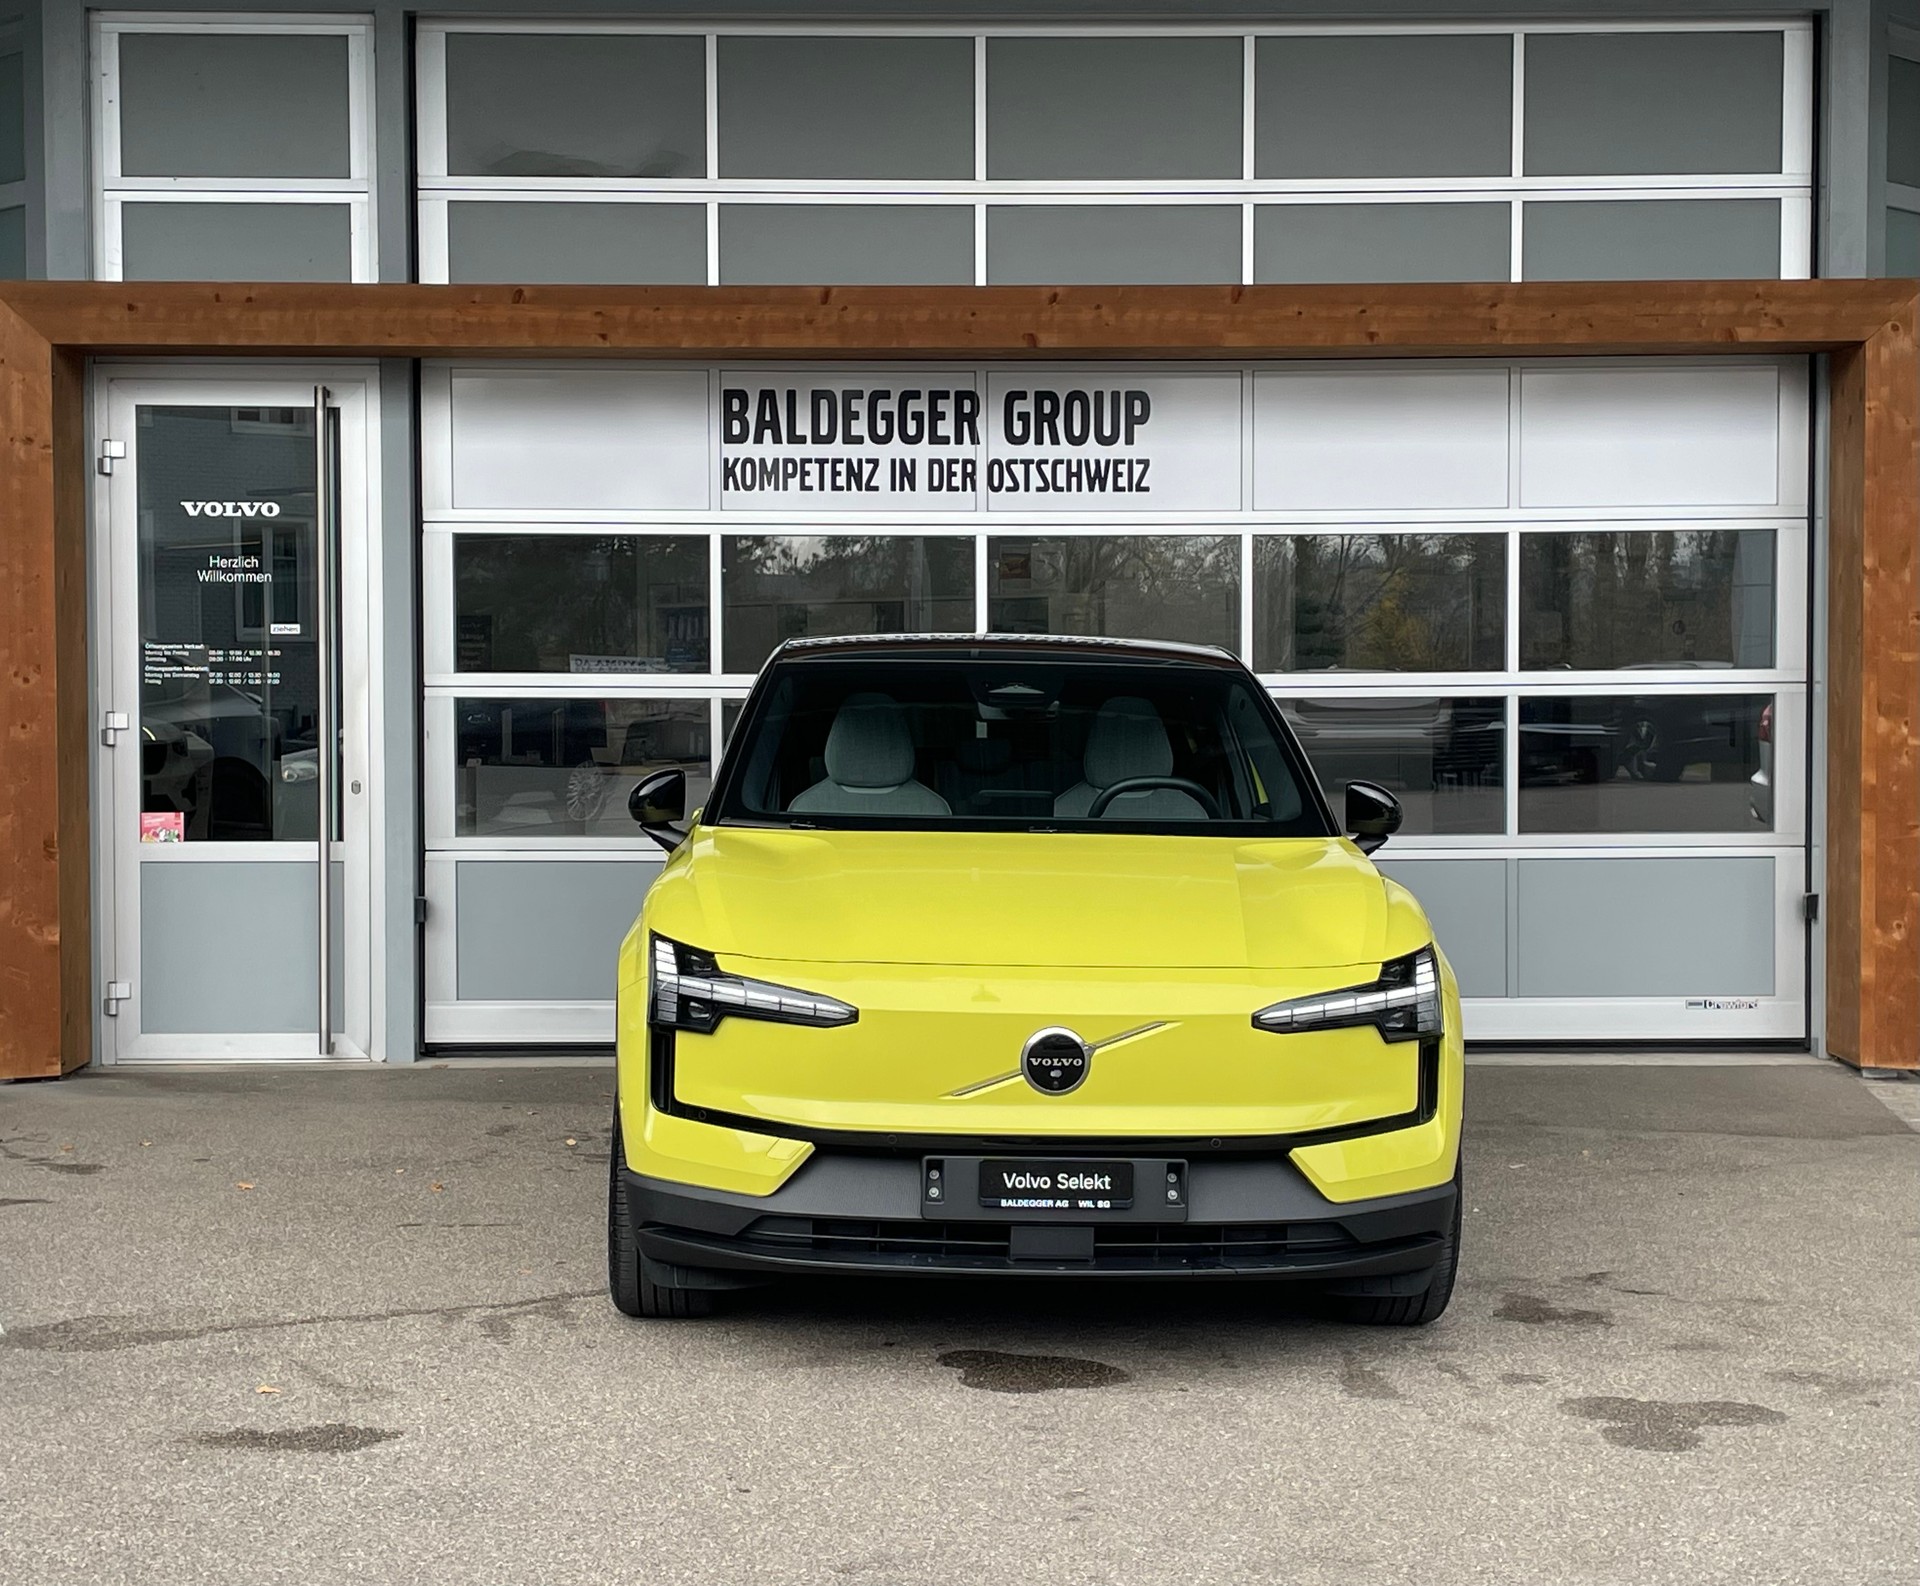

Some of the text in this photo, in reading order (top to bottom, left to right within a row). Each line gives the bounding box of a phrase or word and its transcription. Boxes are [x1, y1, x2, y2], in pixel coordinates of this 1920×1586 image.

[722, 389, 1151, 446] BALDEGGER GROUP
[722, 457, 1151, 493] KOMPETENZ IN DER OSTSCHWEIZ
[180, 501, 280, 517] VOLVO
[209, 556, 259, 568] Herzlich
[197, 570, 272, 583] Willkommen
[1029, 1057, 1083, 1067] VOLVO
[1002, 1172, 1112, 1190] Volvo Selekt
[1000, 1199, 1111, 1208] BALDEGGER AG WIL SG
